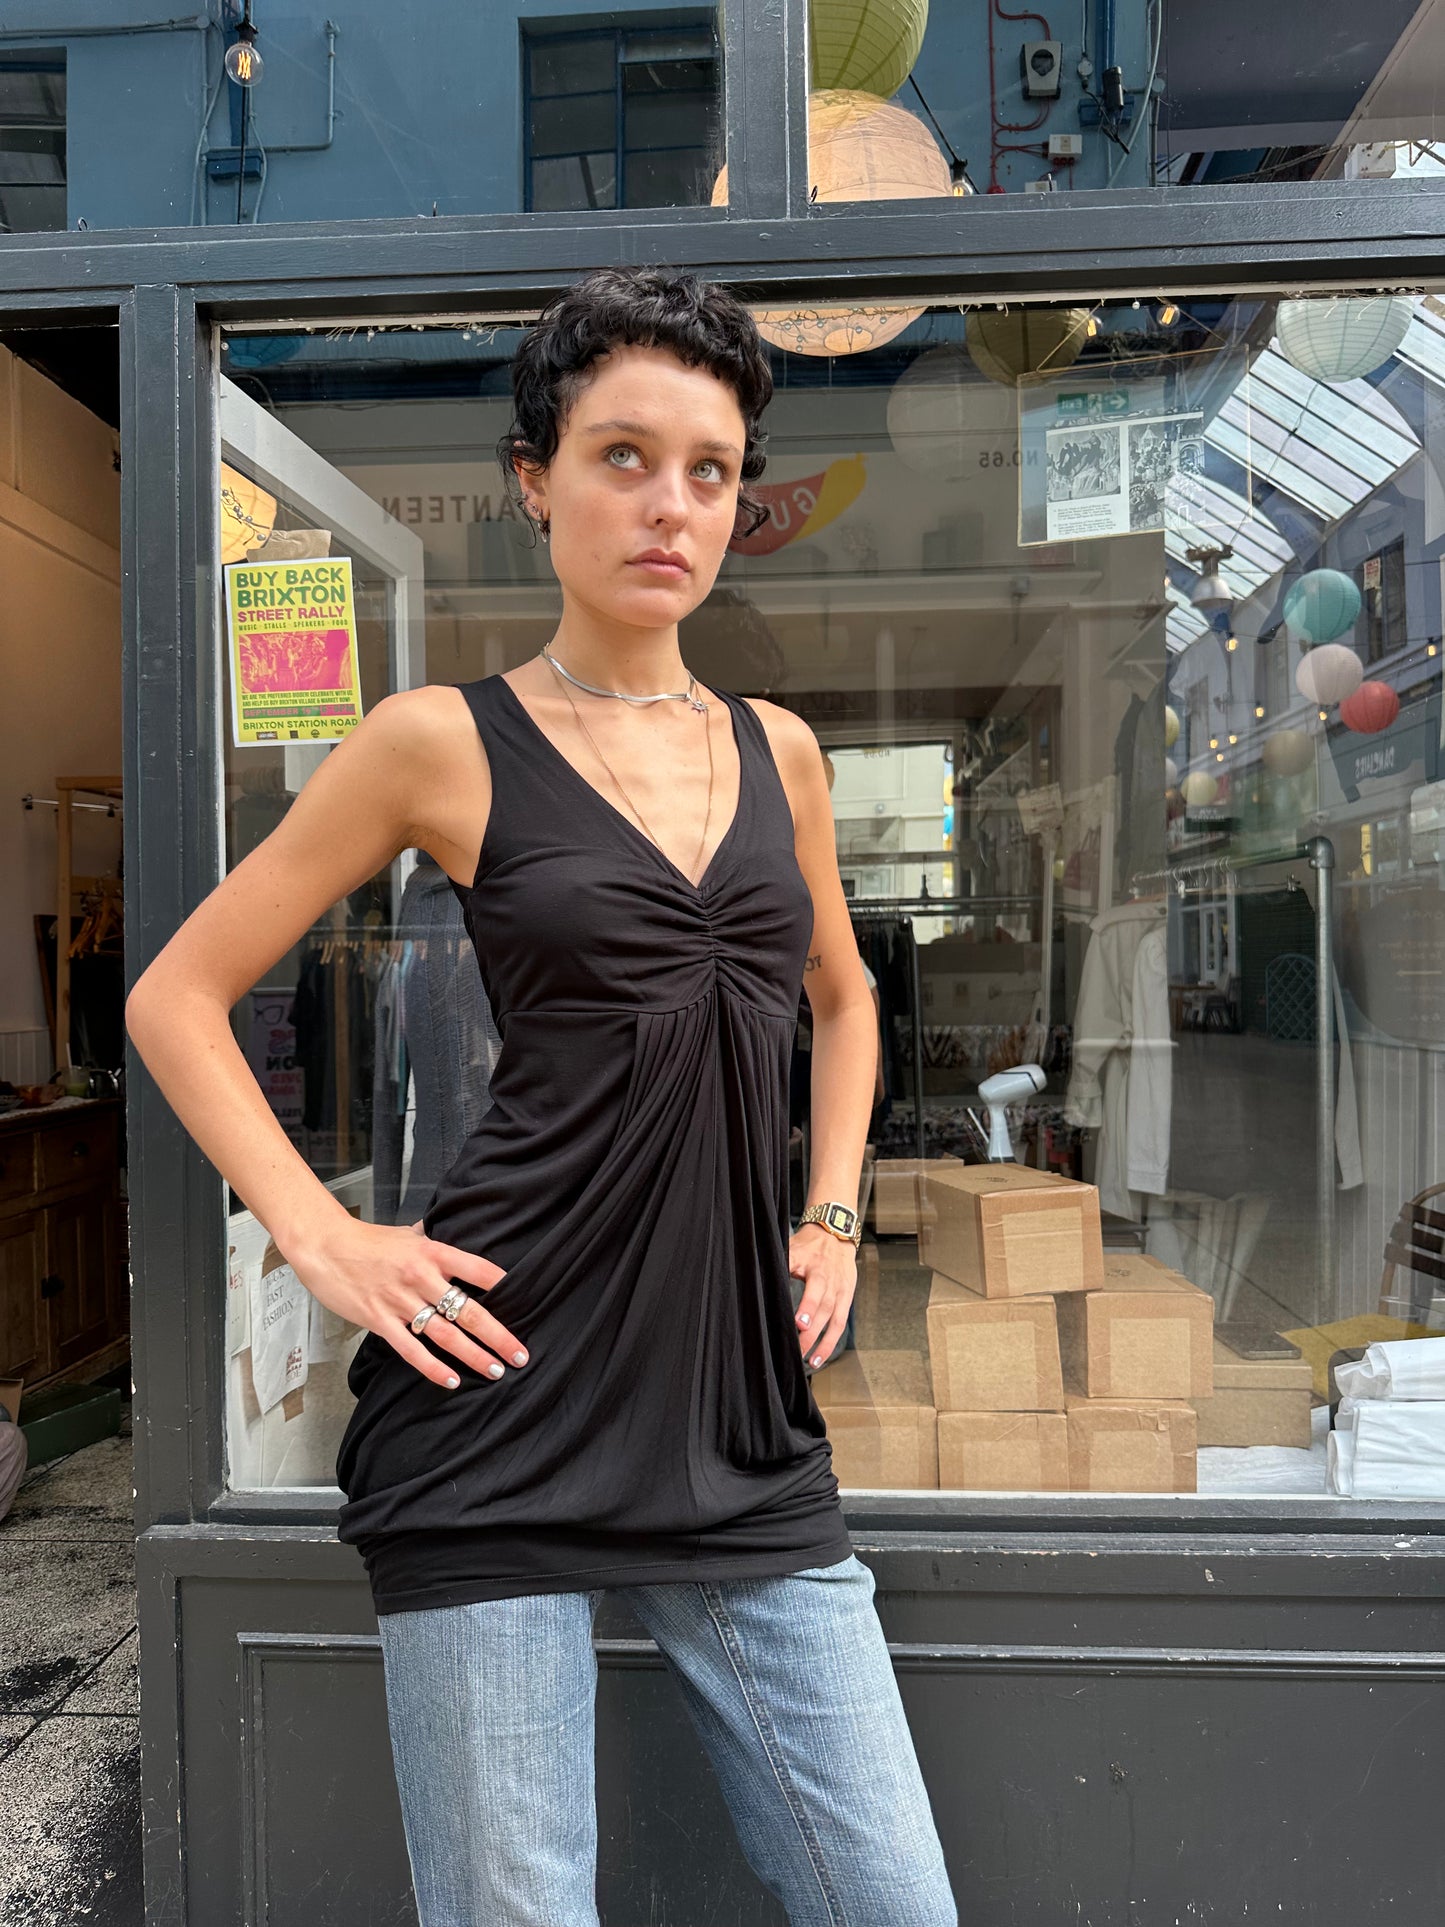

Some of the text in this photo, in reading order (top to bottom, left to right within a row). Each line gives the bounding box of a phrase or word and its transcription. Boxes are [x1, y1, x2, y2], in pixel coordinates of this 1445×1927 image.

[237, 568, 344, 588] BUY BACK
[238, 585, 345, 607] BRIXTON
[238, 606, 345, 622] STREET RALLY
[244, 708, 298, 716] SEPTEMBER
[243, 718, 358, 729] BRIXTON STATION ROAD
[267, 1285, 284, 1307] FAST
[262, 1297, 295, 1331] FASHION
